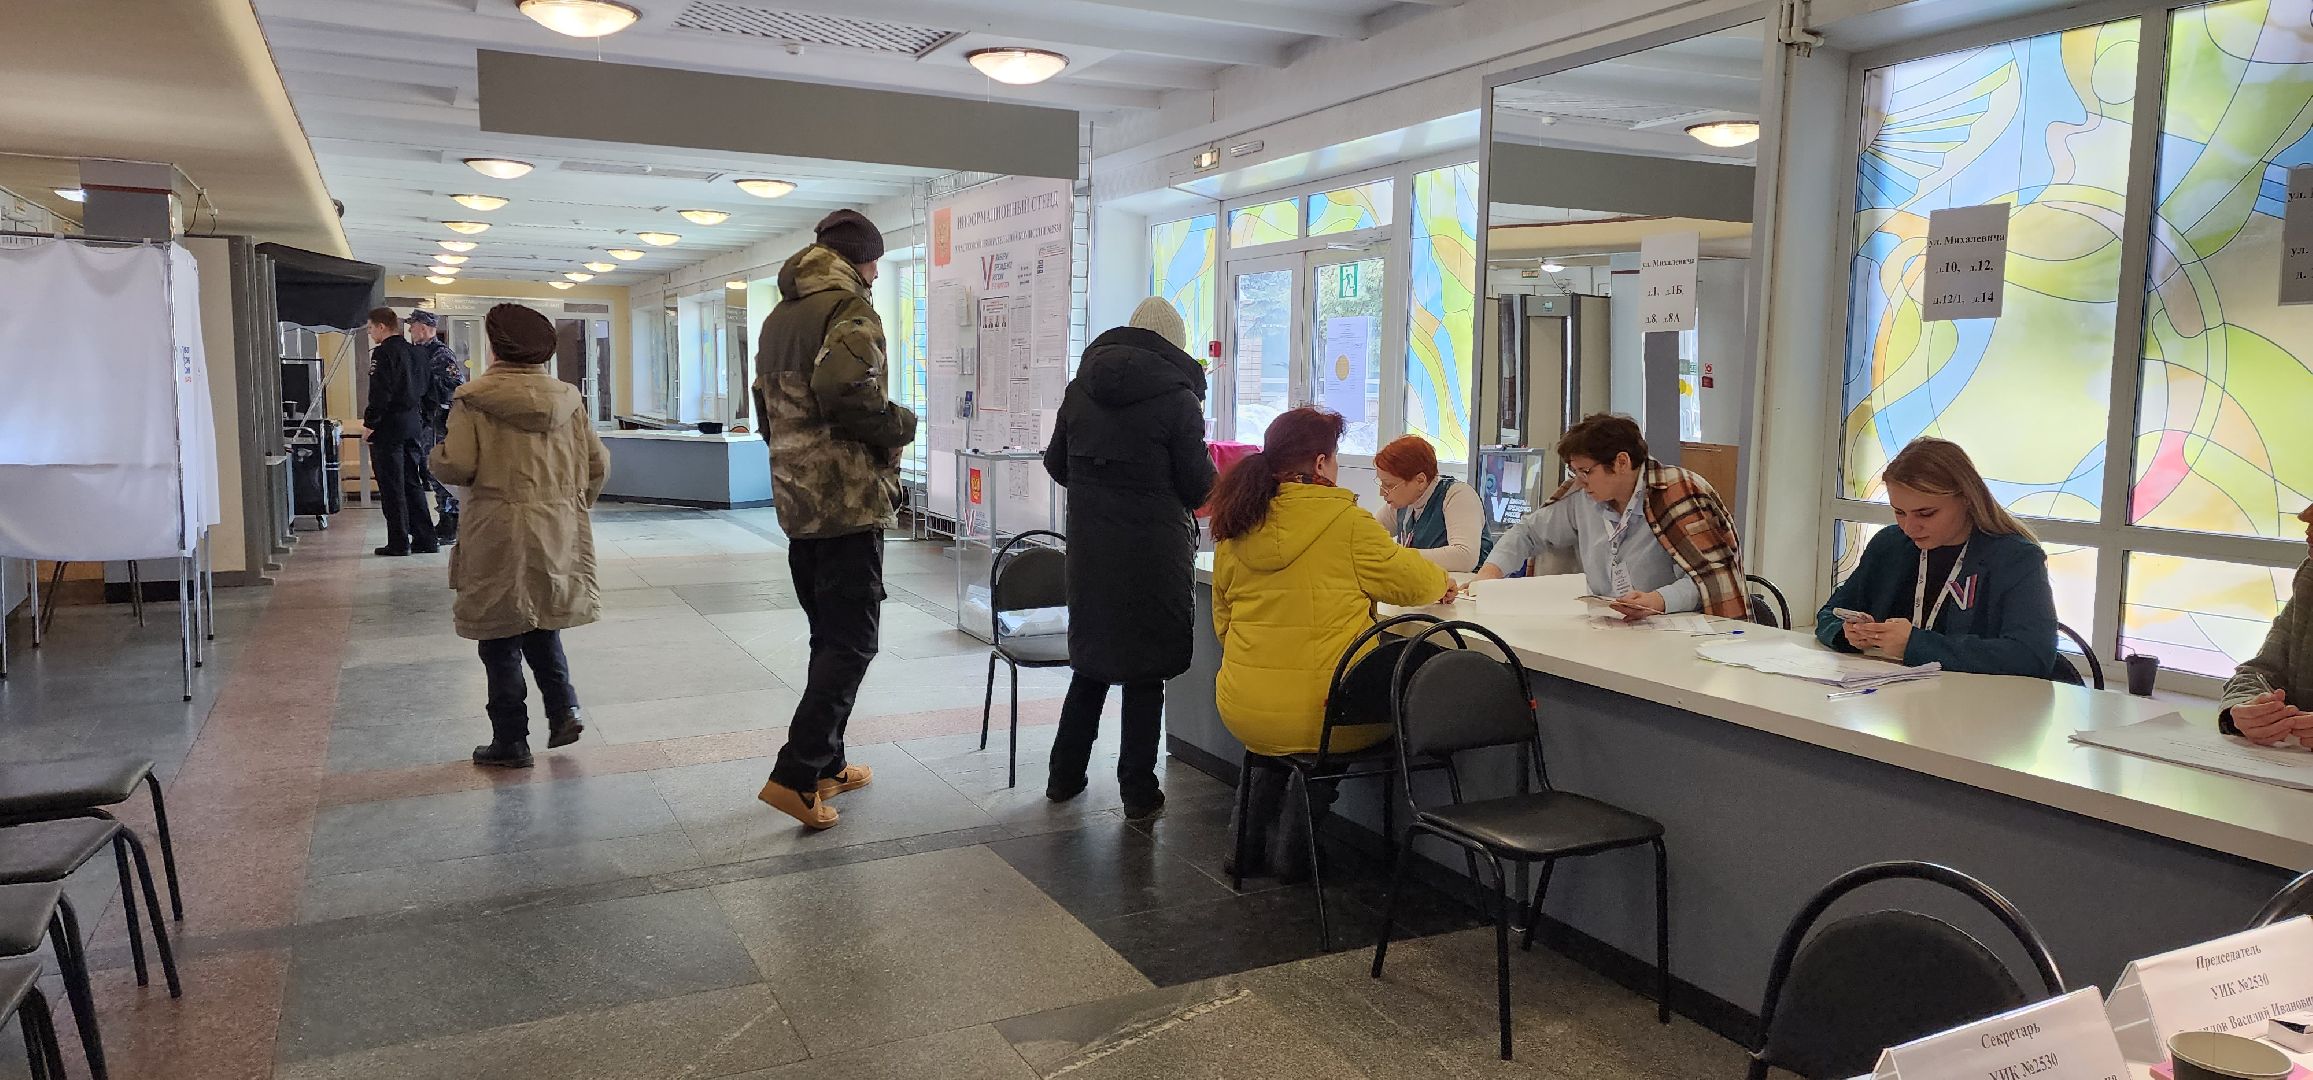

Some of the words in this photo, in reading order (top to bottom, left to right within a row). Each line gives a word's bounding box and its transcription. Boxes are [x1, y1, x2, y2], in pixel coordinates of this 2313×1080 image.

[1944, 234, 2005, 245] Михалевича
[2290, 247, 2309, 257] ул.
[2196, 944, 2262, 971] Председатель
[2210, 981, 2237, 1000] УИК
[2238, 972, 2270, 993] №2530
[2228, 1006, 2271, 1030] Василий
[1981, 1022, 2041, 1049] Секретарь
[2020, 1052, 2059, 1077] №2530
